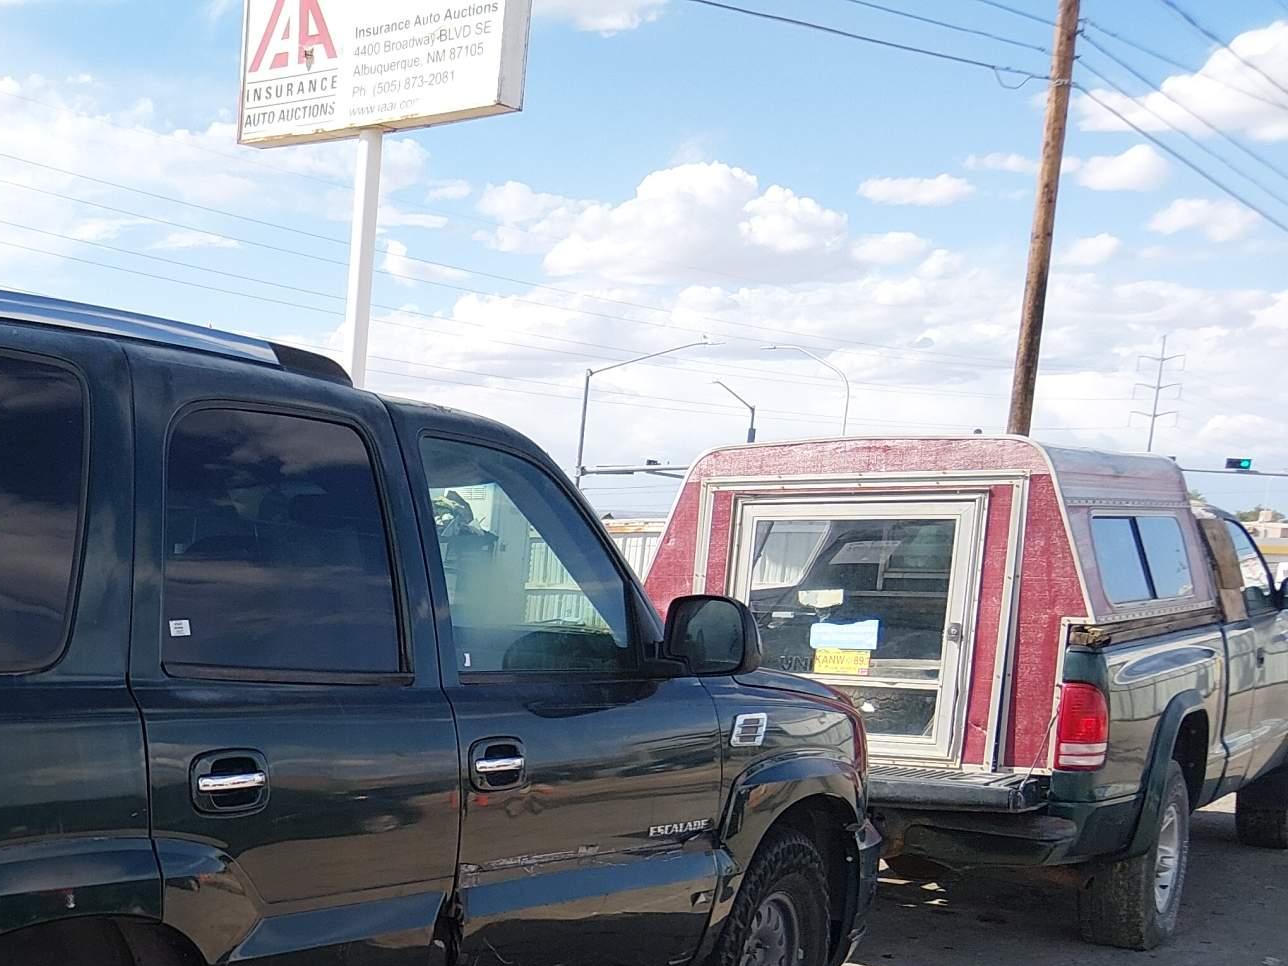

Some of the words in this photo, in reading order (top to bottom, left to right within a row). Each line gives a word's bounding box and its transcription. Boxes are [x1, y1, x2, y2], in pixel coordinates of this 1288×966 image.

[355, 19, 411, 40] Insurance
[414, 12, 441, 27] Auto
[443, 2, 499, 22] Auctions
[353, 42, 381, 57] 4400
[383, 32, 435, 54] Broadway
[439, 24, 472, 42] BLVD
[475, 20, 493, 35] SE
[426, 49, 446, 64] NM
[449, 41, 484, 61] 87105
[246, 74, 338, 103] INSURANCE
[373, 78, 401, 97] (505)
[403, 70, 456, 90] 873-2081
[244, 111, 276, 128] AUTO
[277, 101, 336, 123] AUCTIONS
[814, 655, 846, 665] KANW
[648, 819, 710, 838] ESCALADE
